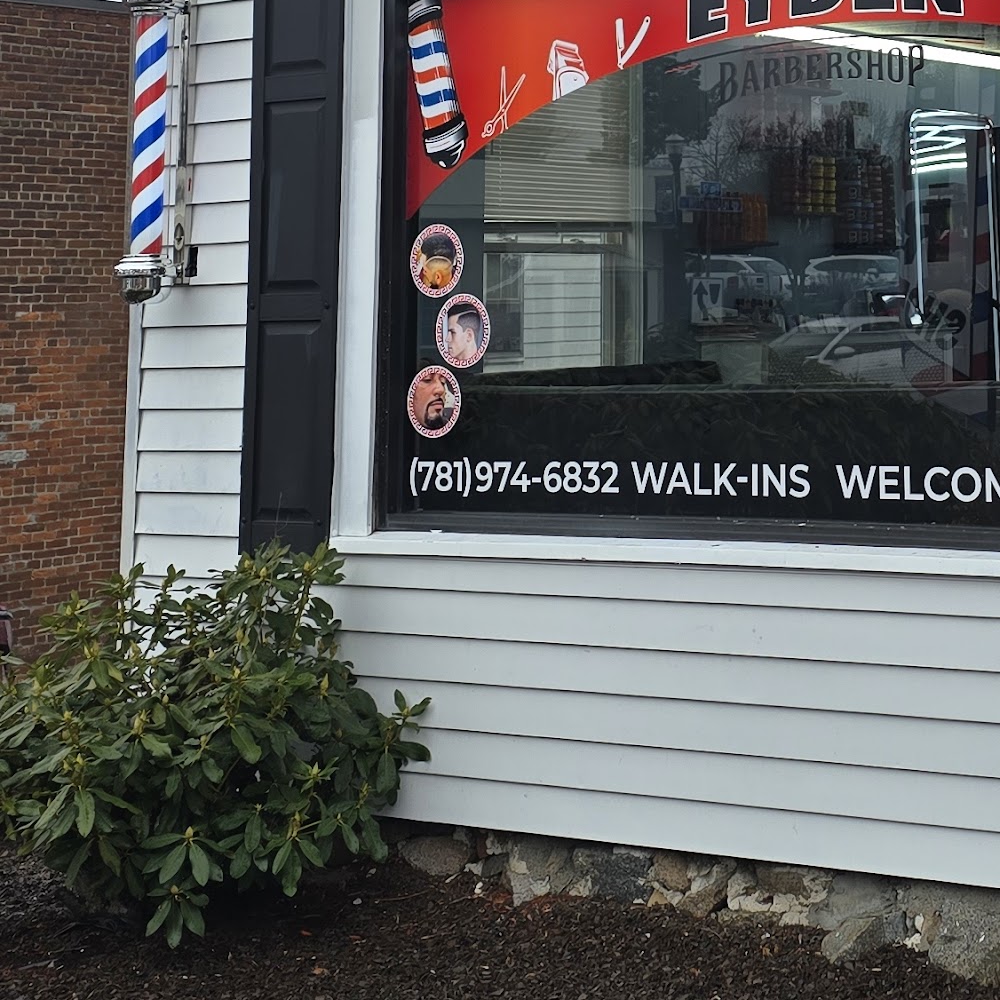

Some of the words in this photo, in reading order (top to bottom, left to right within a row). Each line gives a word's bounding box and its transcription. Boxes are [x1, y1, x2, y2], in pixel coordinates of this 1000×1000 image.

[713, 45, 924, 105] BARBERSHOP
[409, 456, 620, 498] (781)974-6832
[630, 461, 812, 499] WALK-INS
